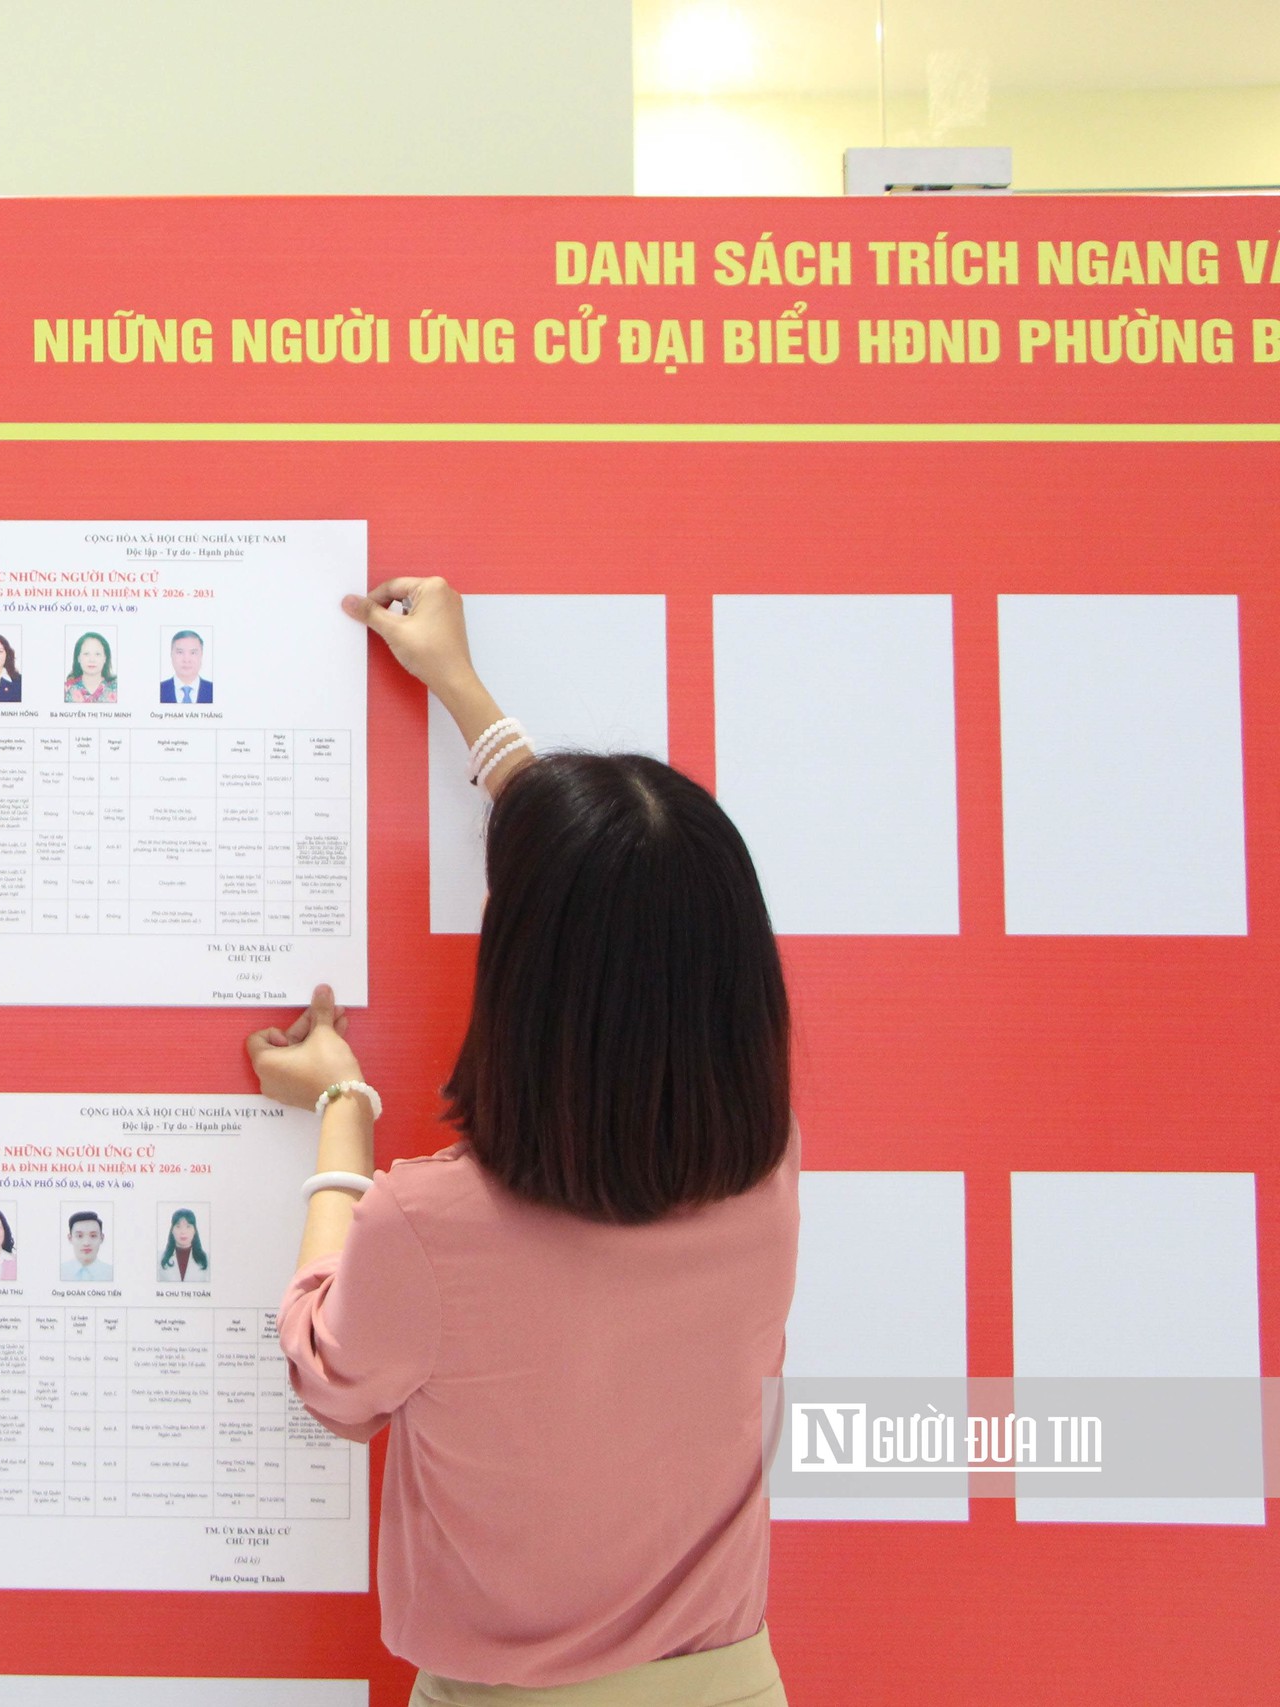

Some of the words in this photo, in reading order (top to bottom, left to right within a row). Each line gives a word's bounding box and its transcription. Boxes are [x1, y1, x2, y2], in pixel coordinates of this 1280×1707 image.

[556, 241, 696, 285] DANH
[714, 231, 851, 286] SÁCH
[868, 231, 1019, 286] TRÍCH
[1037, 239, 1219, 286] NGANG
[34, 309, 213, 364] NHỮNG
[232, 307, 389, 364] NGƯỜI
[409, 309, 514, 364] ỨNG
[534, 304, 606, 364] CỬ
[618, 319, 704, 374] ĐẠI
[723, 301, 840, 363] BIỂU
[859, 319, 1001, 363] HĐND
[1021, 308, 1233, 364] PHƯỜNG
[84, 535, 113, 544] CỘNG
[141, 534, 153, 542] XÃ
[157, 534, 175, 544] HỘI
[178, 534, 198, 542] CHỦ
[202, 534, 233, 543] NGHĨA
[237, 534, 260, 544] VIỆT
[263, 535, 286, 543] NAM
[10, 570, 56, 582] NHỮNG
[61, 570, 104, 582] NGƯỜI
[109, 570, 136, 582] ỨNG
[140, 570, 159, 582] CỬ
[7, 588, 20, 597] BA
[25, 586, 52, 597] ĐÌNH
[56, 586, 88, 597] KHOÁ
[91, 589, 99, 597] II
[103, 587, 140, 599] NHIỆM
[144, 587, 159, 597] KỲ
[162, 589, 184, 597] 2026
[193, 589, 214, 598] 2031
[5, 1144, 52, 1157] NHỮNG
[56, 1144, 100, 1157] NGƯỜI
[104, 1144, 132, 1157] ỨNG
[136, 1145, 155, 1157] CỬ
[13, 1178, 31, 1187] DÂN
[34, 1178, 53, 1188] PHỐ
[56, 1178, 67, 1188] SỐ
[70, 1181, 80, 1189] 03,
[83, 1181, 94, 1189] 04,
[108, 1179, 120, 1188] VÀ
[210, 1574, 231, 1583] Phạm
[234, 1575, 259, 1583] Quang
